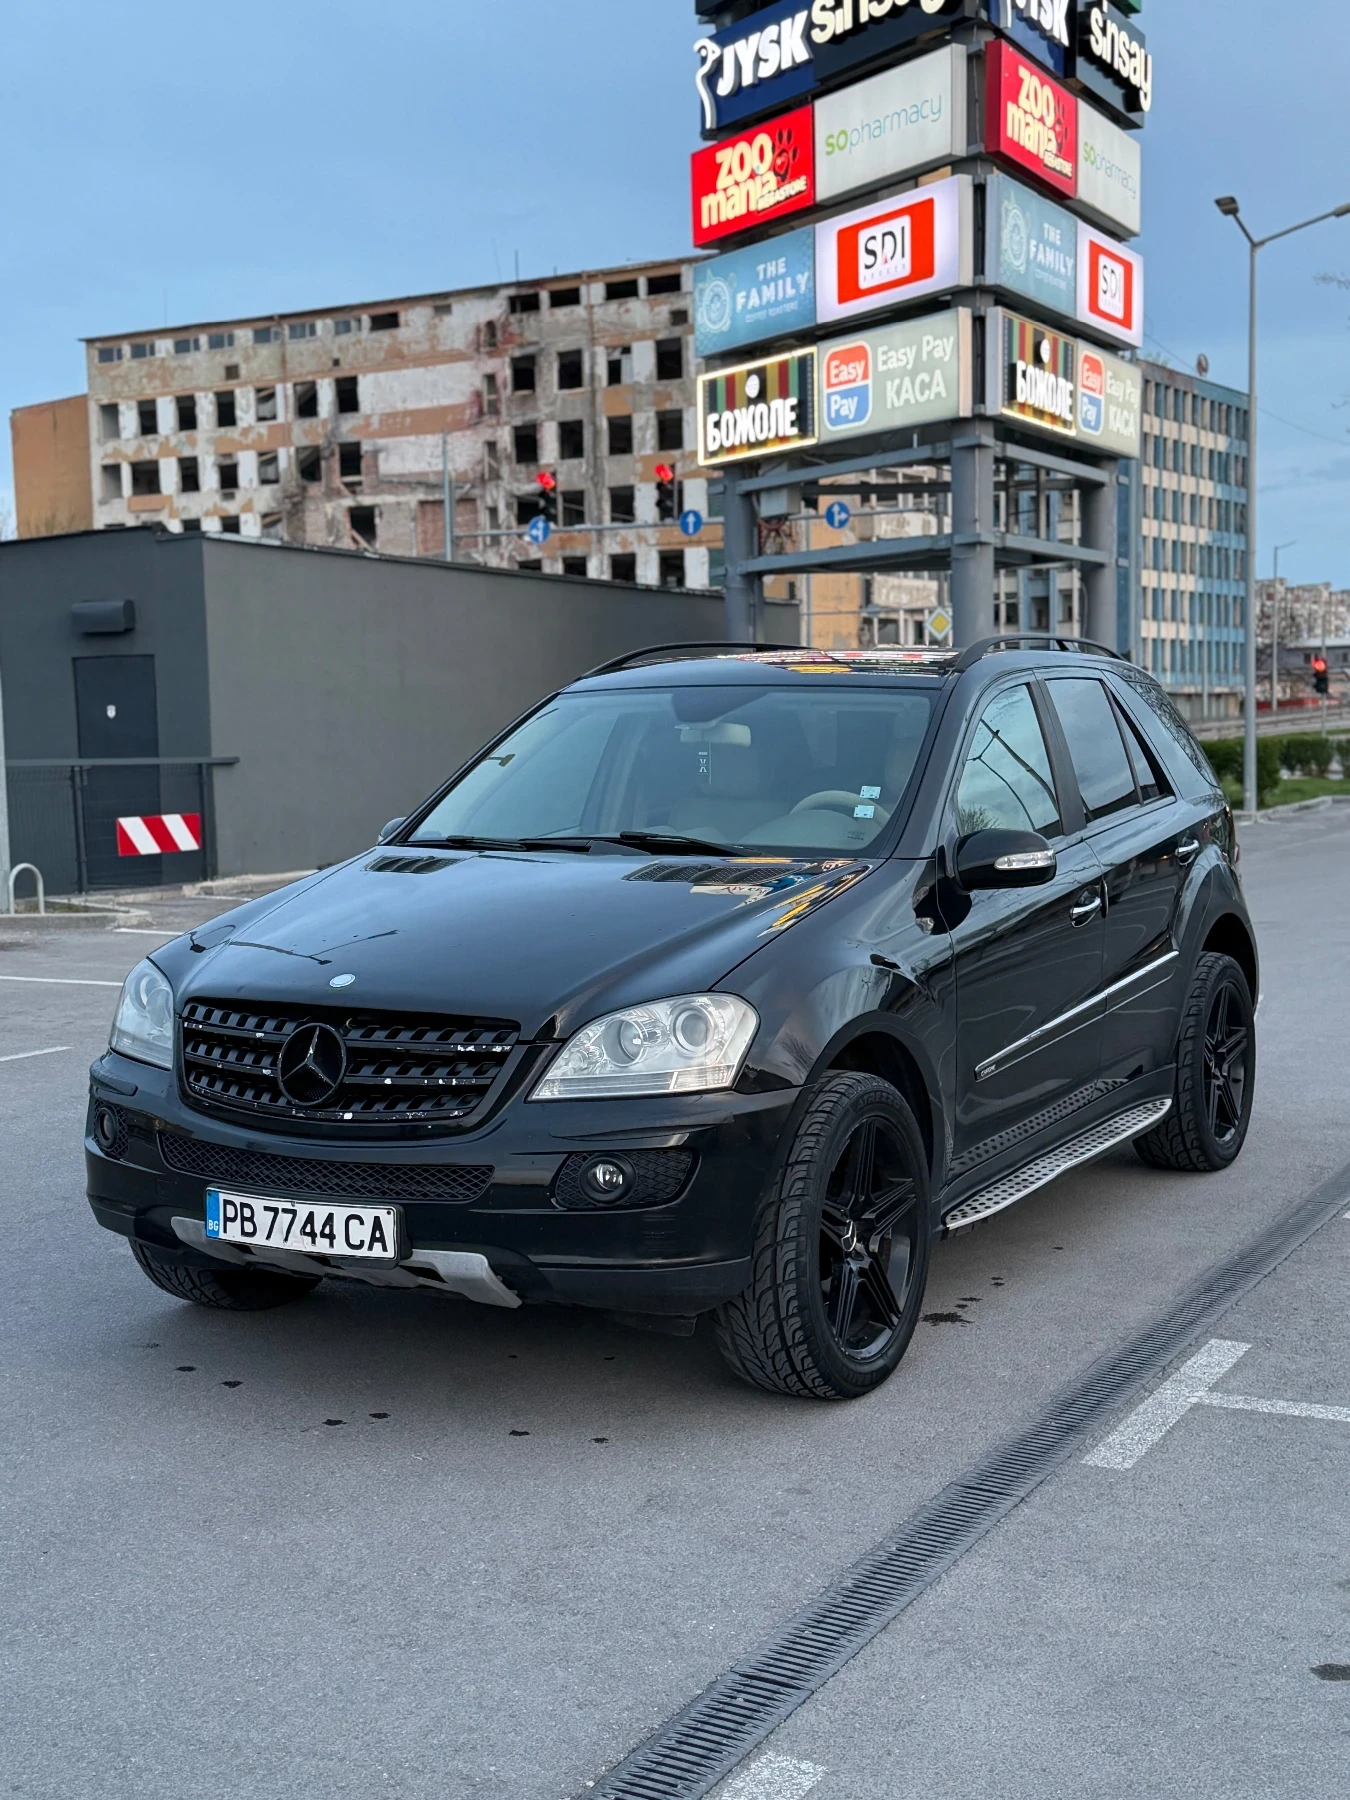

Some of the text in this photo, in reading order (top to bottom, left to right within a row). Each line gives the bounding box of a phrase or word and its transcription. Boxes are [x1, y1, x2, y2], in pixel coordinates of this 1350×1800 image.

[717, 10, 810, 96] JYSK
[1089, 2, 1152, 112] sinsay
[825, 94, 942, 156] sopharmacy
[1006, 101, 1057, 160] mania
[701, 171, 777, 229] mania
[864, 226, 905, 269] SDI
[1043, 223, 1062, 246] THE
[755, 257, 787, 281] THE
[1029, 239, 1074, 277] FAMILY
[736, 272, 809, 313] FAMILY
[1101, 264, 1122, 303] SDI
[829, 359, 867, 384] Easy
[877, 335, 954, 372] Easy Pay
[1016, 360, 1073, 421] БОЖОЛЕ
[1083, 363, 1103, 394] Easy
[1106, 370, 1125, 403] Easy
[706, 397, 799, 451] БОЖОЛЕ
[830, 395, 859, 420] Pay
[1082, 397, 1098, 427] Pay
[208, 1219, 219, 1232] BG
[222, 1199, 389, 1252] PB 7744 CA
